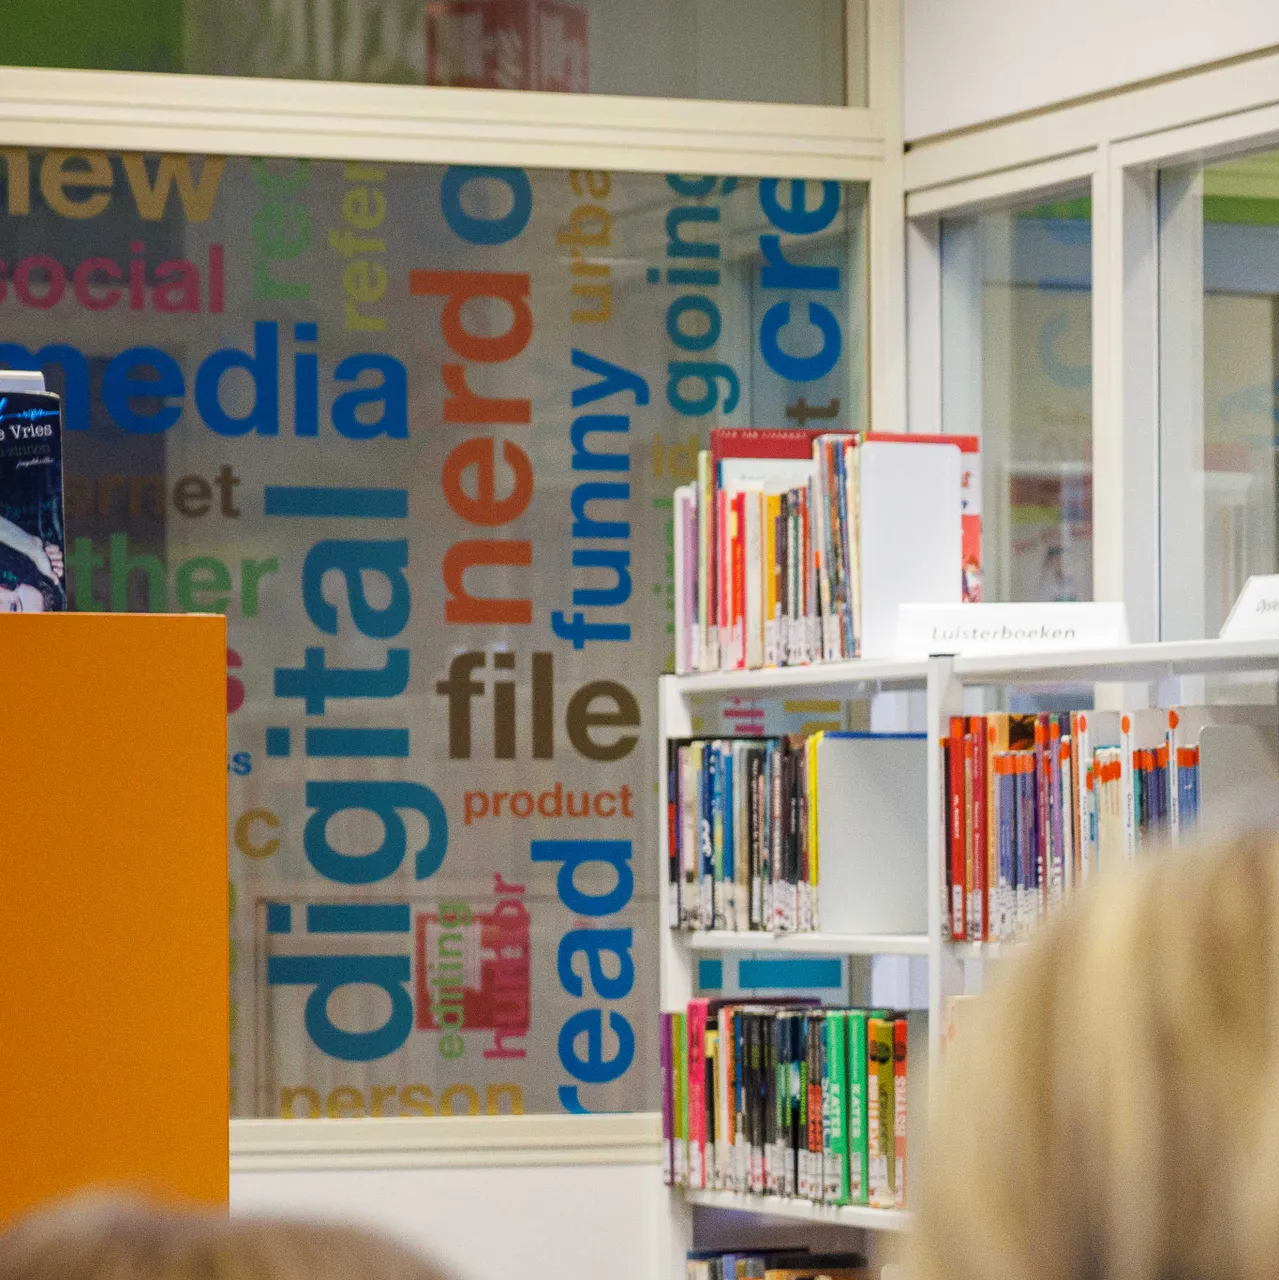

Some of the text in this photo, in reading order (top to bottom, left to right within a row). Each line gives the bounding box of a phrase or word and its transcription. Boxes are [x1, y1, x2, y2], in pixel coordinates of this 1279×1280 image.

[9, 423, 53, 440] Vries
[409, 269, 534, 625] nerd
[551, 347, 651, 651] funny
[264, 486, 449, 1061] digital
[436, 651, 641, 762] file
[464, 782, 633, 826] product
